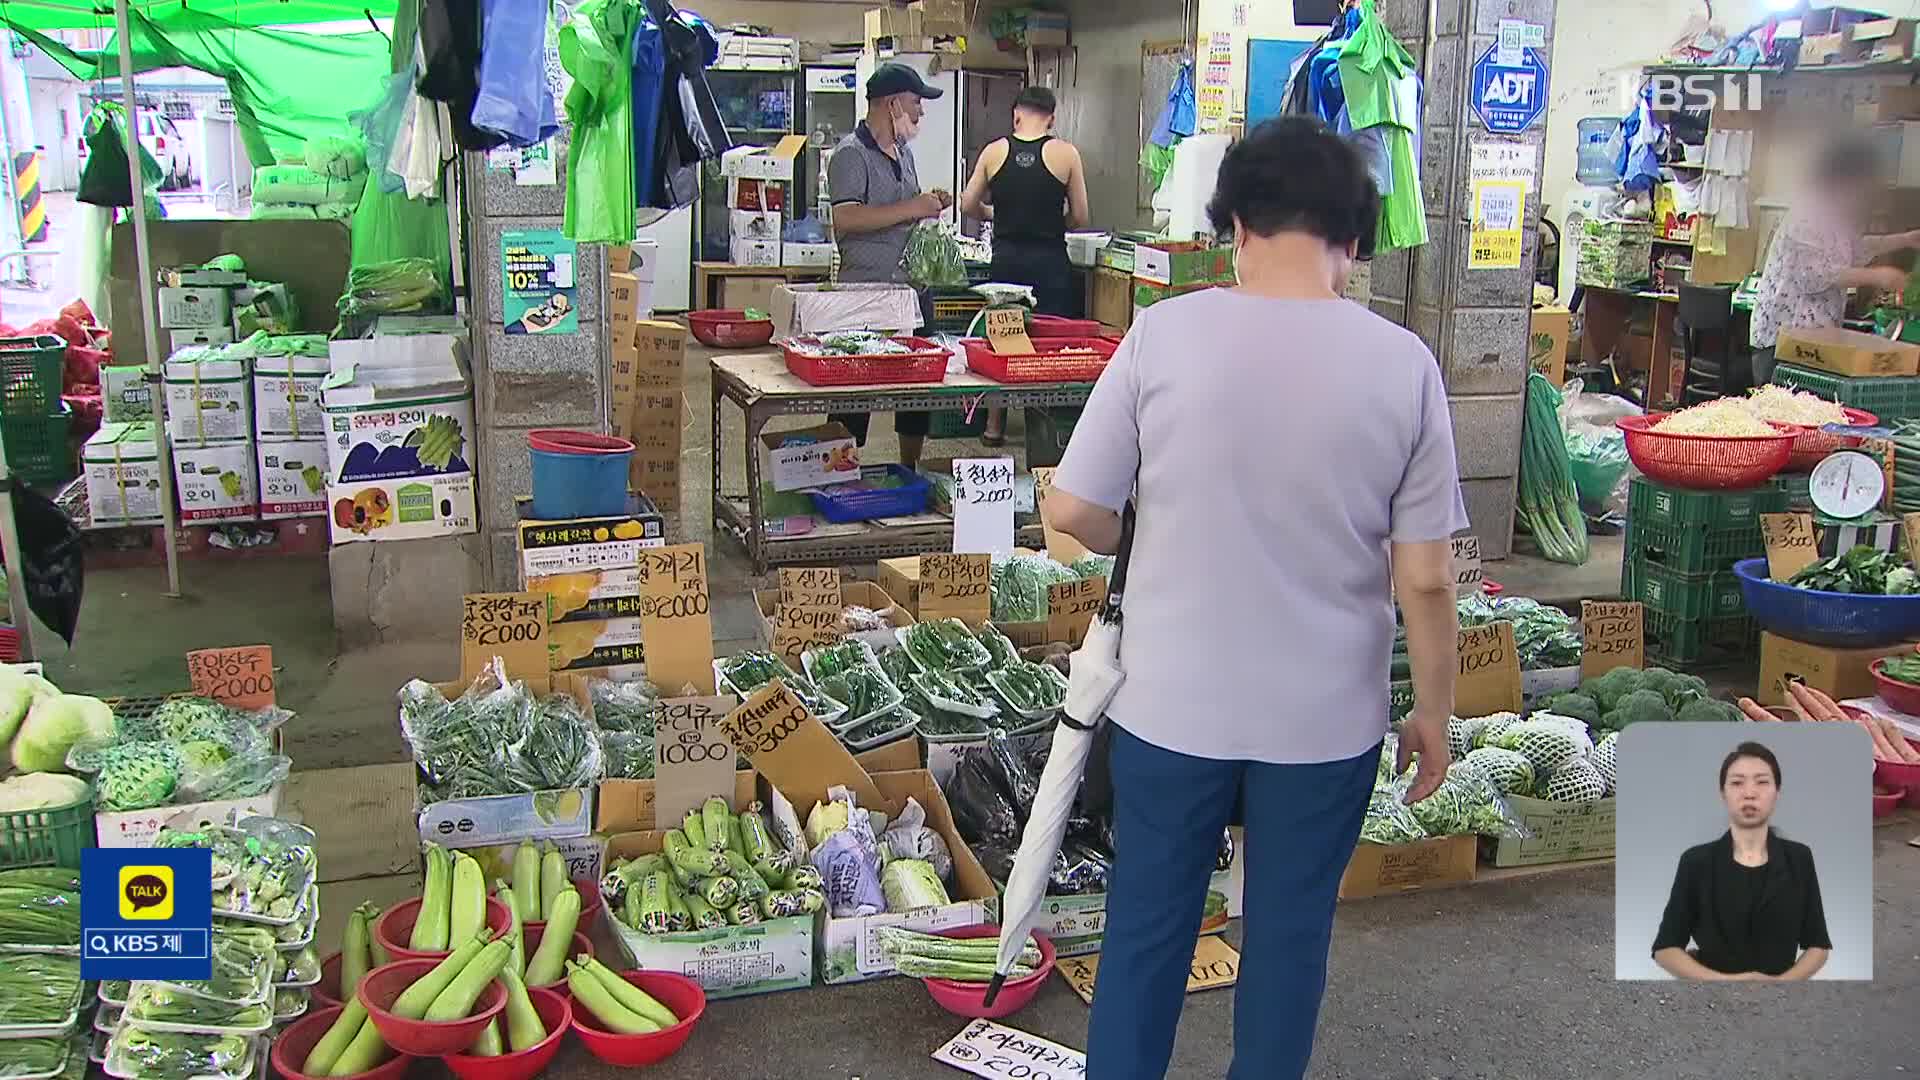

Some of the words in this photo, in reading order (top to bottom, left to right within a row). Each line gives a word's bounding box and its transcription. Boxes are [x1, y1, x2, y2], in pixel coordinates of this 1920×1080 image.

[1483, 72, 1536, 104] ADT
[507, 271, 538, 289] 10%
[399, 409, 426, 424] 오이
[796, 568, 838, 590] 생강
[1060, 579, 1097, 600] 비트
[656, 593, 708, 618] 2000
[479, 620, 541, 645] 2000
[1459, 649, 1504, 676] 1000
[211, 674, 273, 699] 2000
[757, 704, 809, 753] 3000
[660, 743, 728, 765] 1000
